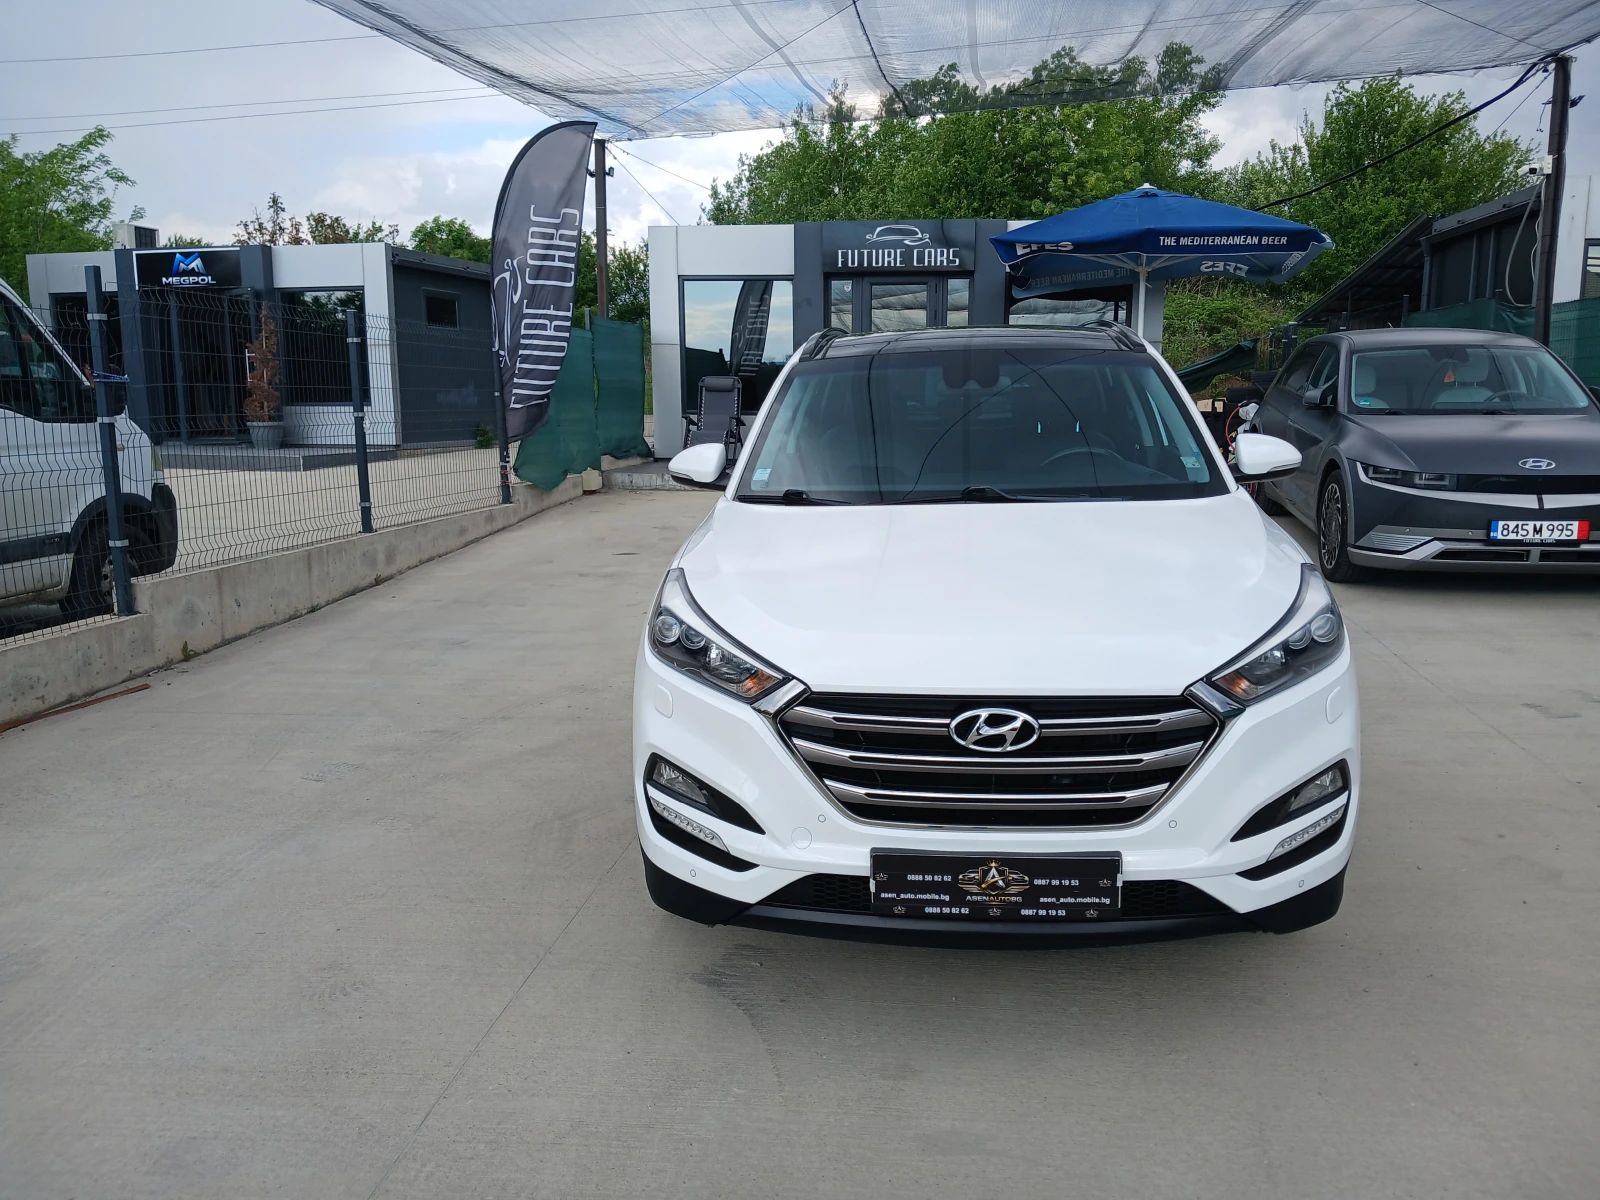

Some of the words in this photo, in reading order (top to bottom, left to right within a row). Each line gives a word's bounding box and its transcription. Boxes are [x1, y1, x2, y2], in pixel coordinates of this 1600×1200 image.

[525, 204, 580, 288] CARS
[1159, 236, 1178, 246] THE
[1179, 234, 1259, 246] MEDITERRANEAN
[1261, 236, 1288, 246] BEER
[837, 248, 906, 268] FUTURE
[913, 247, 960, 267] CARS
[161, 275, 216, 286] MEGPOL
[509, 299, 573, 409] FUTURE
[1500, 523, 1529, 537] 845
[1546, 523, 1574, 537] 995
